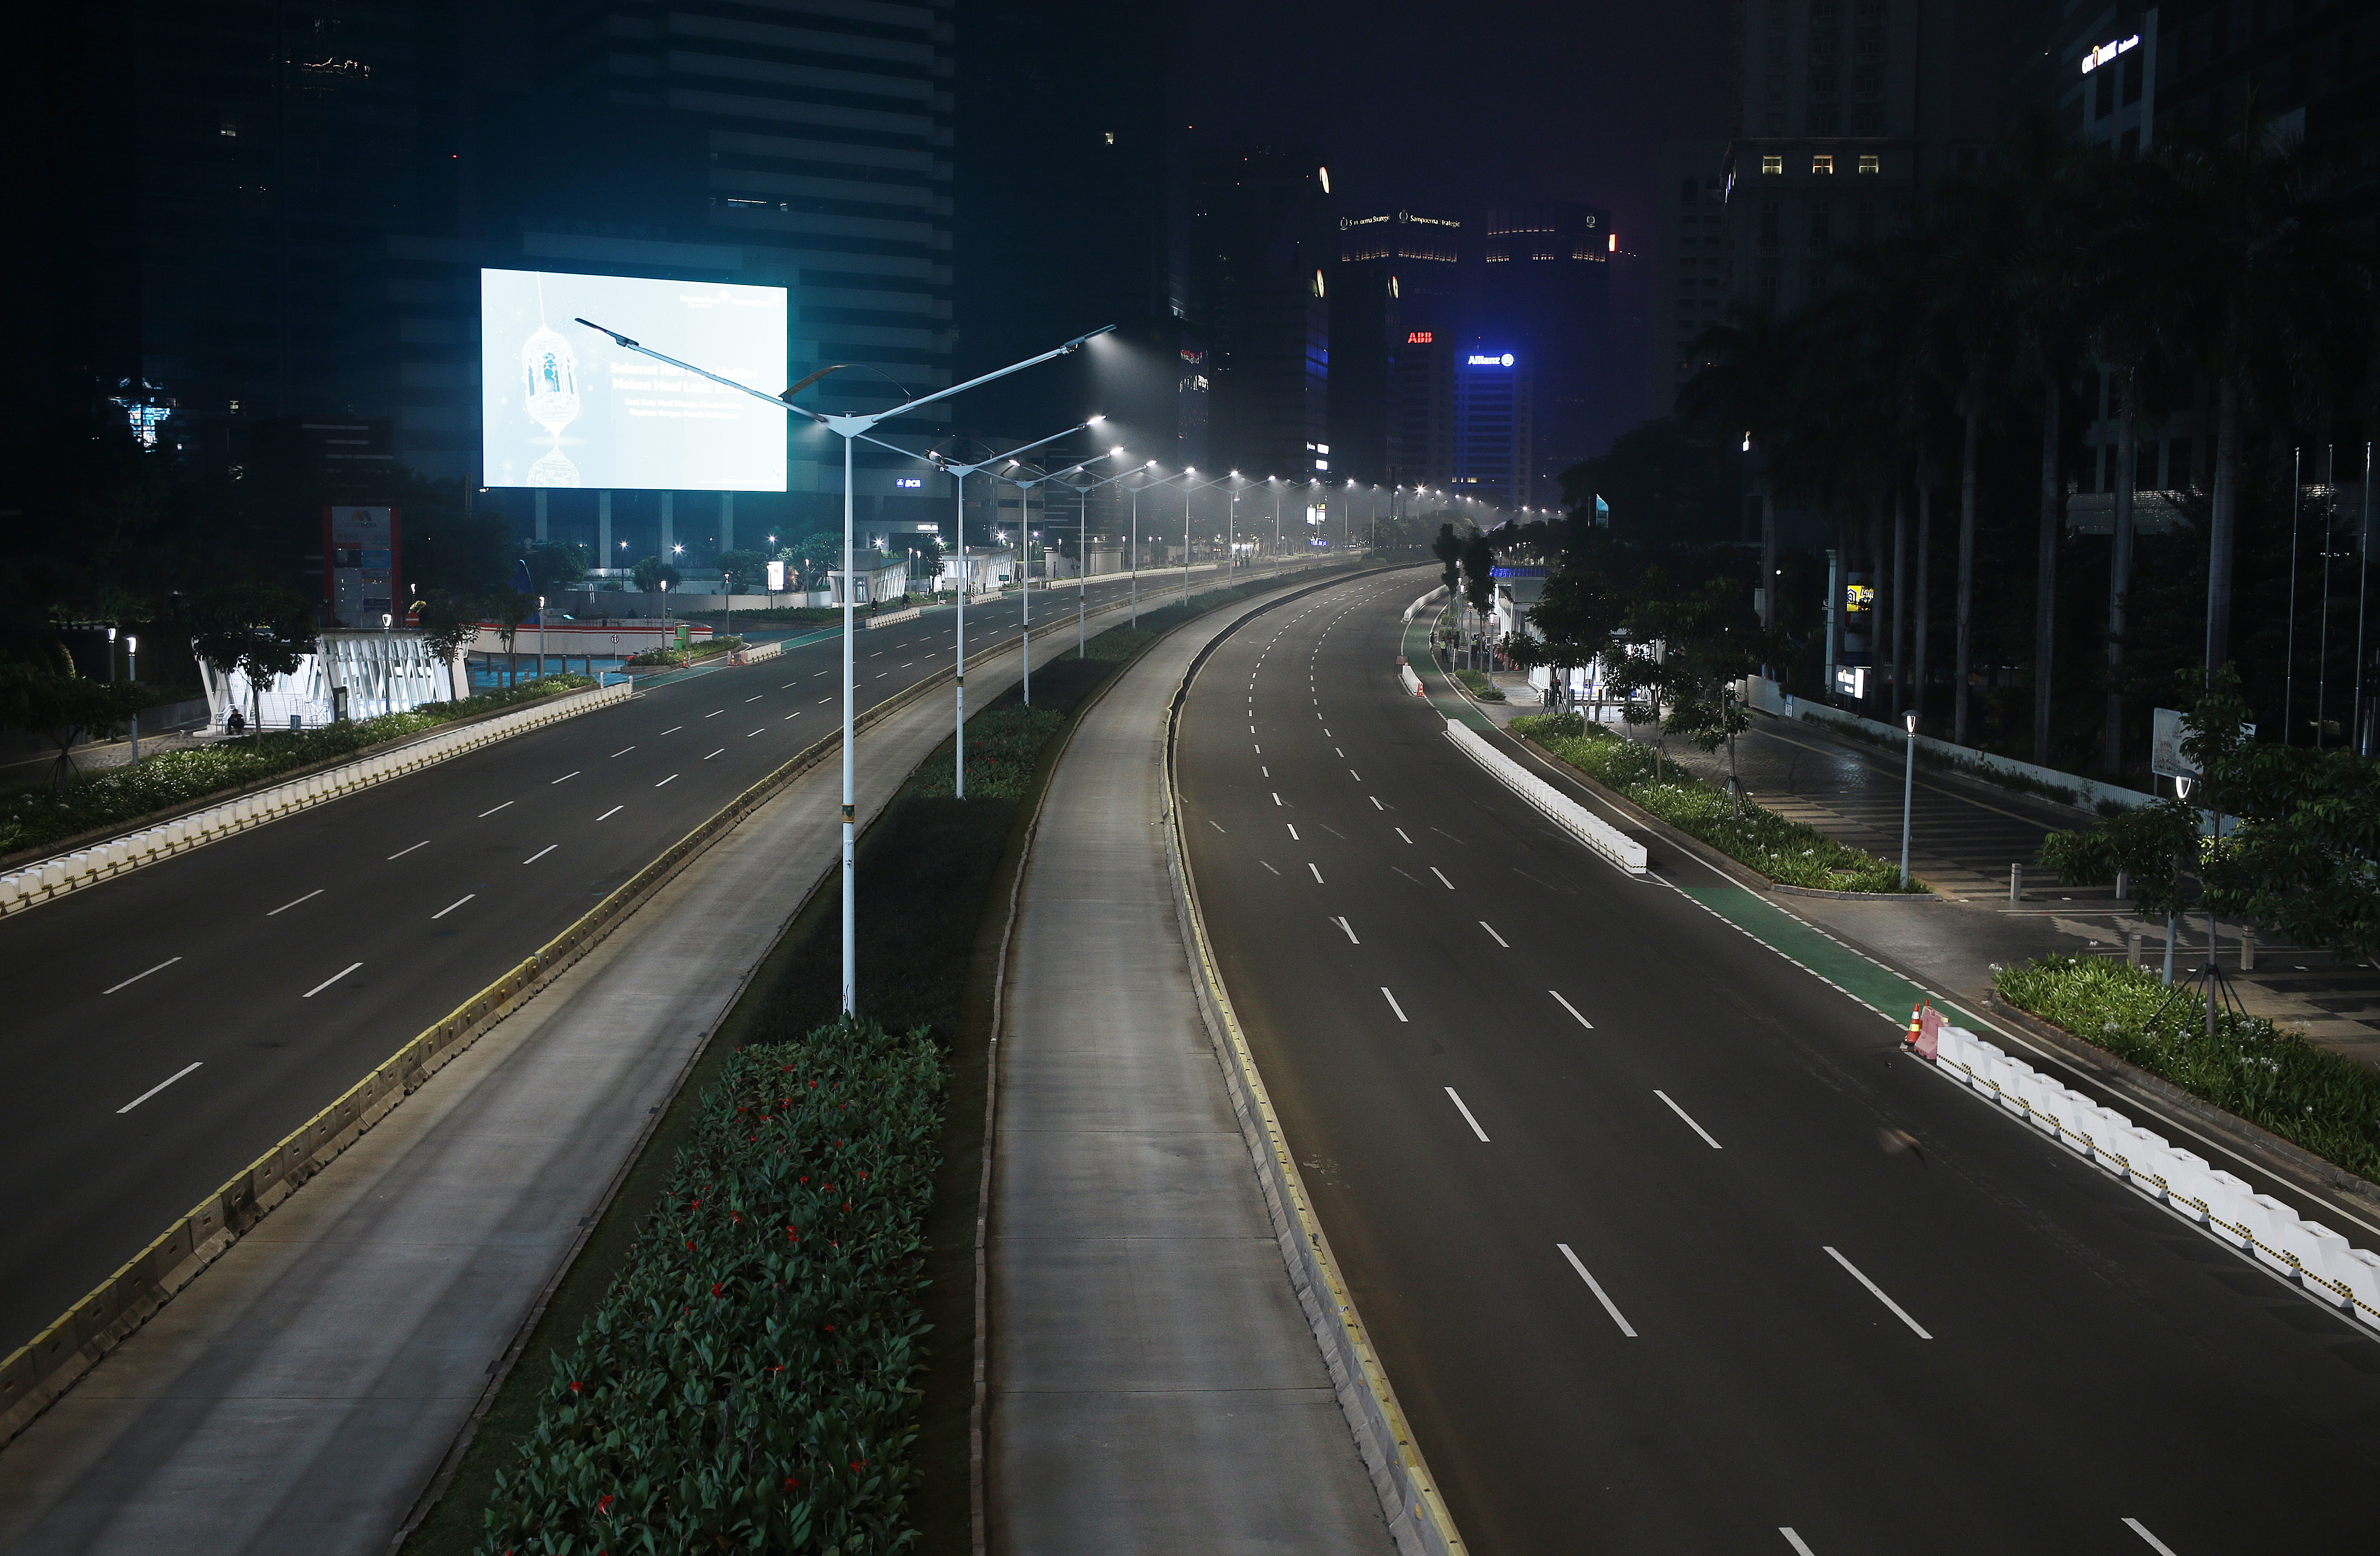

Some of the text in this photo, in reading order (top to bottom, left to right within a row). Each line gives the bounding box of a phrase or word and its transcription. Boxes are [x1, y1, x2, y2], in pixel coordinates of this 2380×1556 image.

[1349, 218, 1373, 227] Smoerna
[1410, 214, 1439, 225] Sampoerna
[1408, 332, 1433, 343] ABB
[1467, 355, 1501, 365] Allianz
[610, 362, 658, 375] Selamat
[613, 377, 652, 391] Mohon
[653, 379, 682, 392] Maaf
[684, 381, 713, 393] Lahir
[904, 479, 921, 487] BCA
